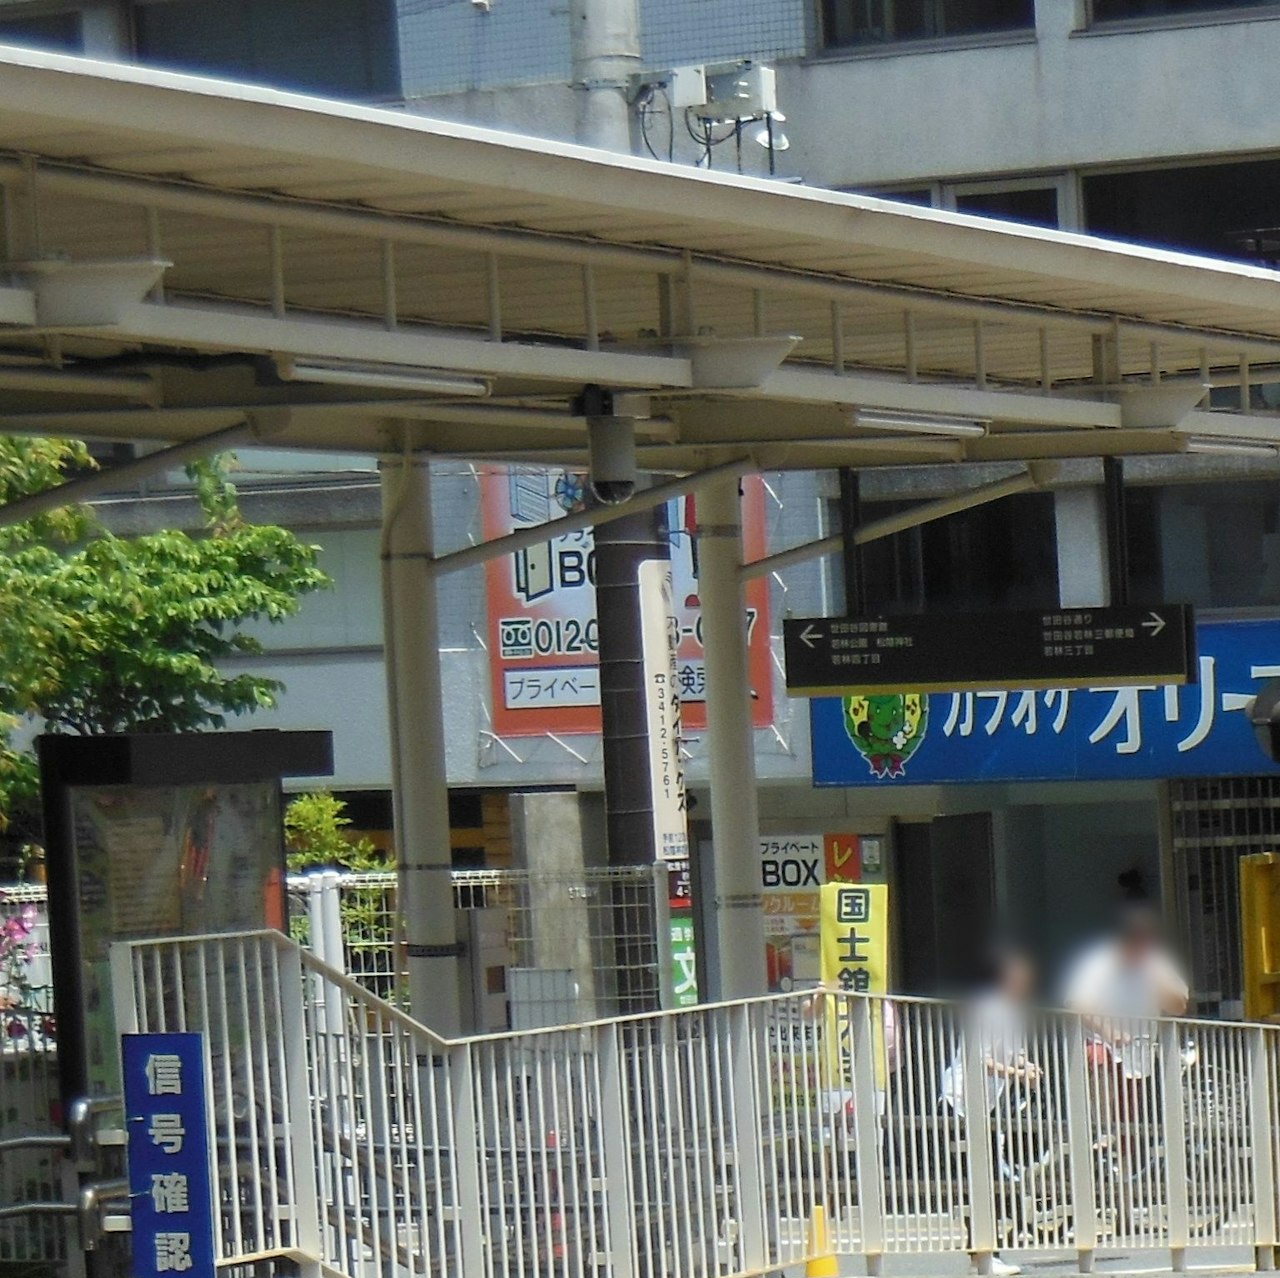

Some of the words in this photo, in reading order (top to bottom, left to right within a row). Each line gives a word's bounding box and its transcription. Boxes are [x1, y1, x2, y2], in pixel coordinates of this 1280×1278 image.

[760, 842, 819, 855] プライベート
[762, 859, 821, 887] BOX
[144, 1053, 193, 1273] 信号確認
